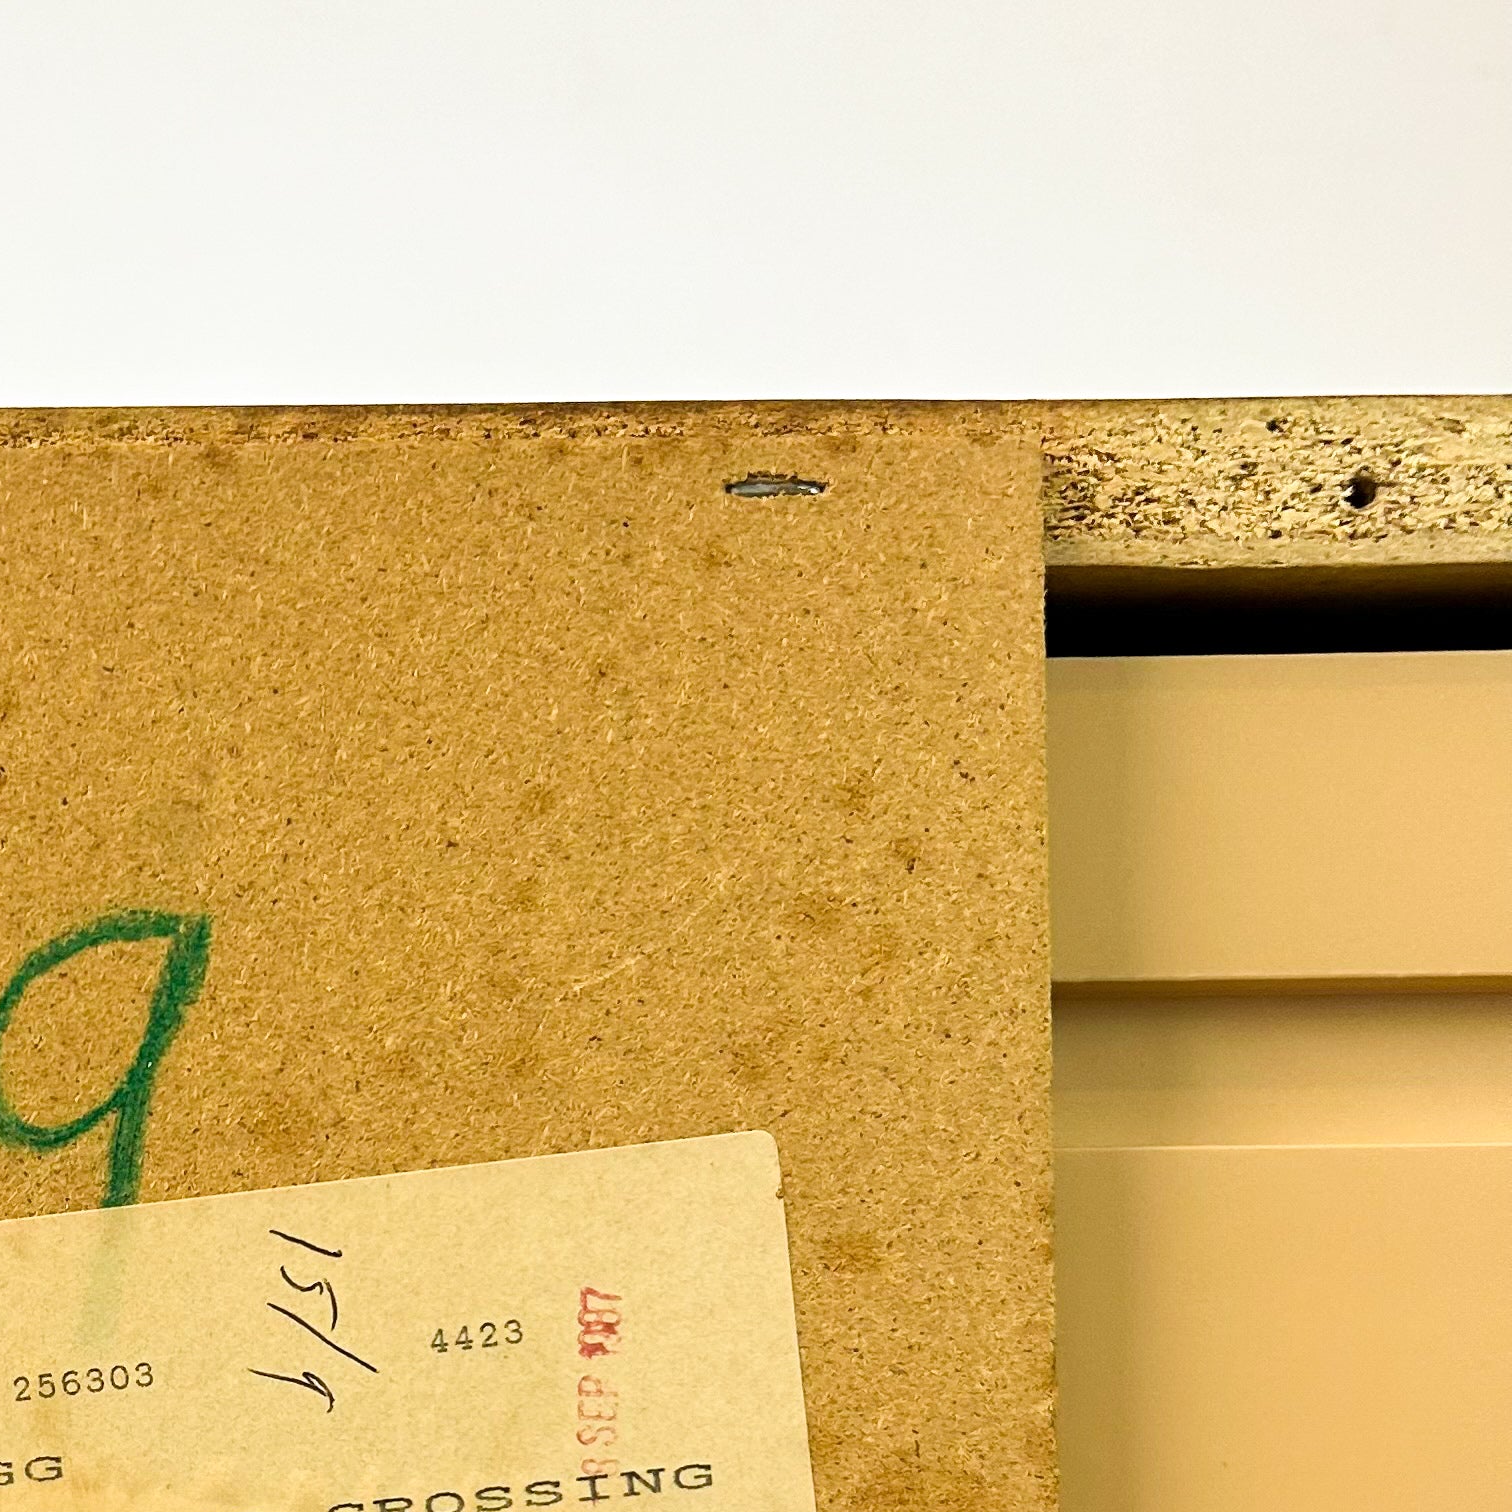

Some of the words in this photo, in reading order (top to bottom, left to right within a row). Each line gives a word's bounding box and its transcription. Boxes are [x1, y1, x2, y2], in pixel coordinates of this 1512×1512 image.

[430, 1318, 526, 1355] 4423
[12, 1362, 156, 1403] 256303
[576, 1374, 620, 1446] SEP
